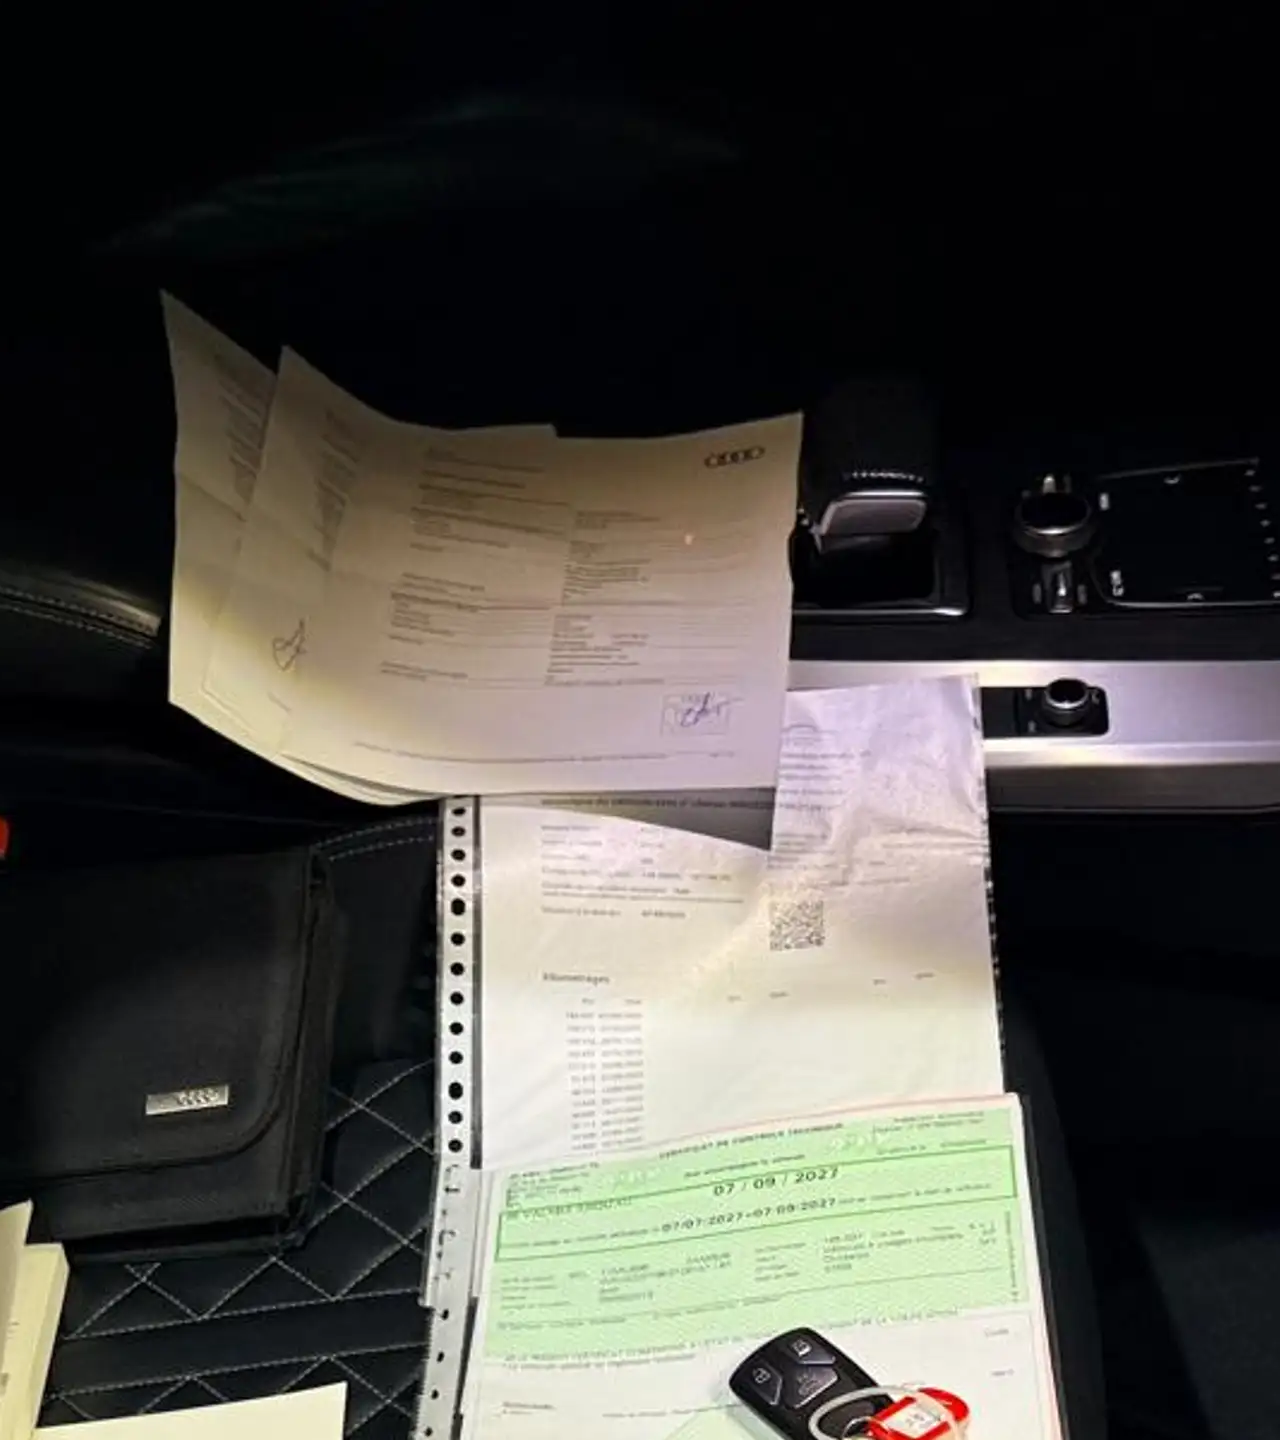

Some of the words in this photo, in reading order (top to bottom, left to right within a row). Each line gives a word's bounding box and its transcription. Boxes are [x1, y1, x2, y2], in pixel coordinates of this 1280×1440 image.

[713, 1183, 735, 1197] 07
[753, 1177, 776, 1190] 09
[794, 1168, 839, 1184] 2027
